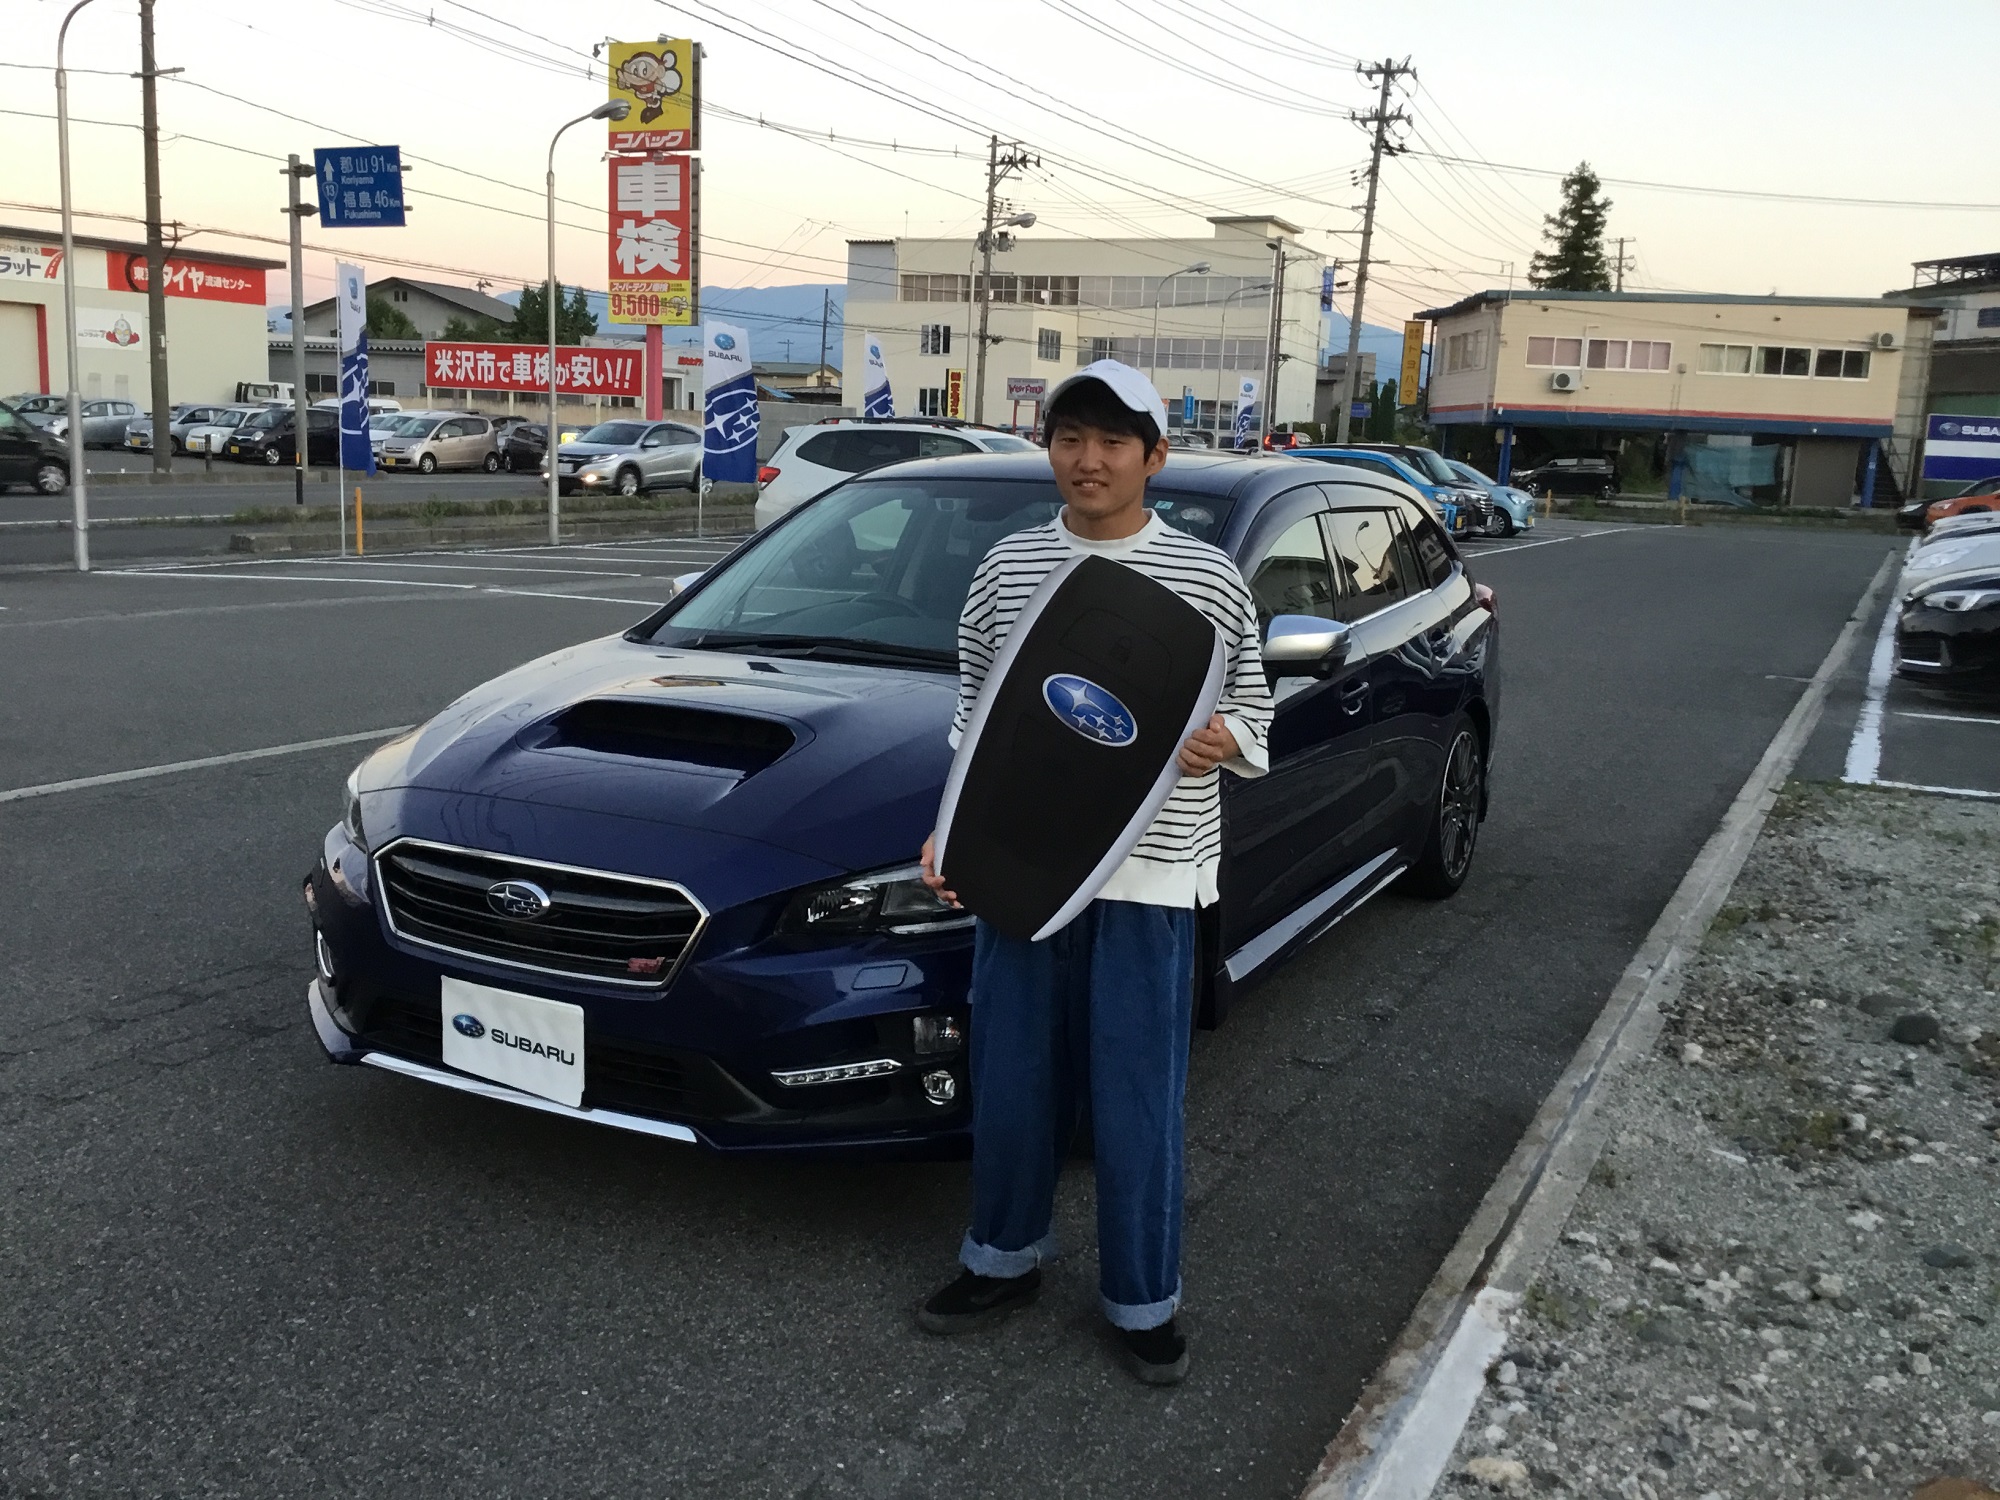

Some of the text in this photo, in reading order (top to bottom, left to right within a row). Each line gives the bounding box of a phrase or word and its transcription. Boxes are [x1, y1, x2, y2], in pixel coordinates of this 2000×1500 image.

[614, 131, 684, 149] コバック
[340, 156, 369, 174] 郡山
[341, 175, 375, 186] Koriyama
[325, 184, 335, 197] 13
[344, 190, 372, 208] 福島
[344, 209, 382, 219] Fukushima
[616, 162, 682, 275] 車検
[708, 350, 743, 363] SUBARU
[491, 1028, 575, 1066] SUBARU
